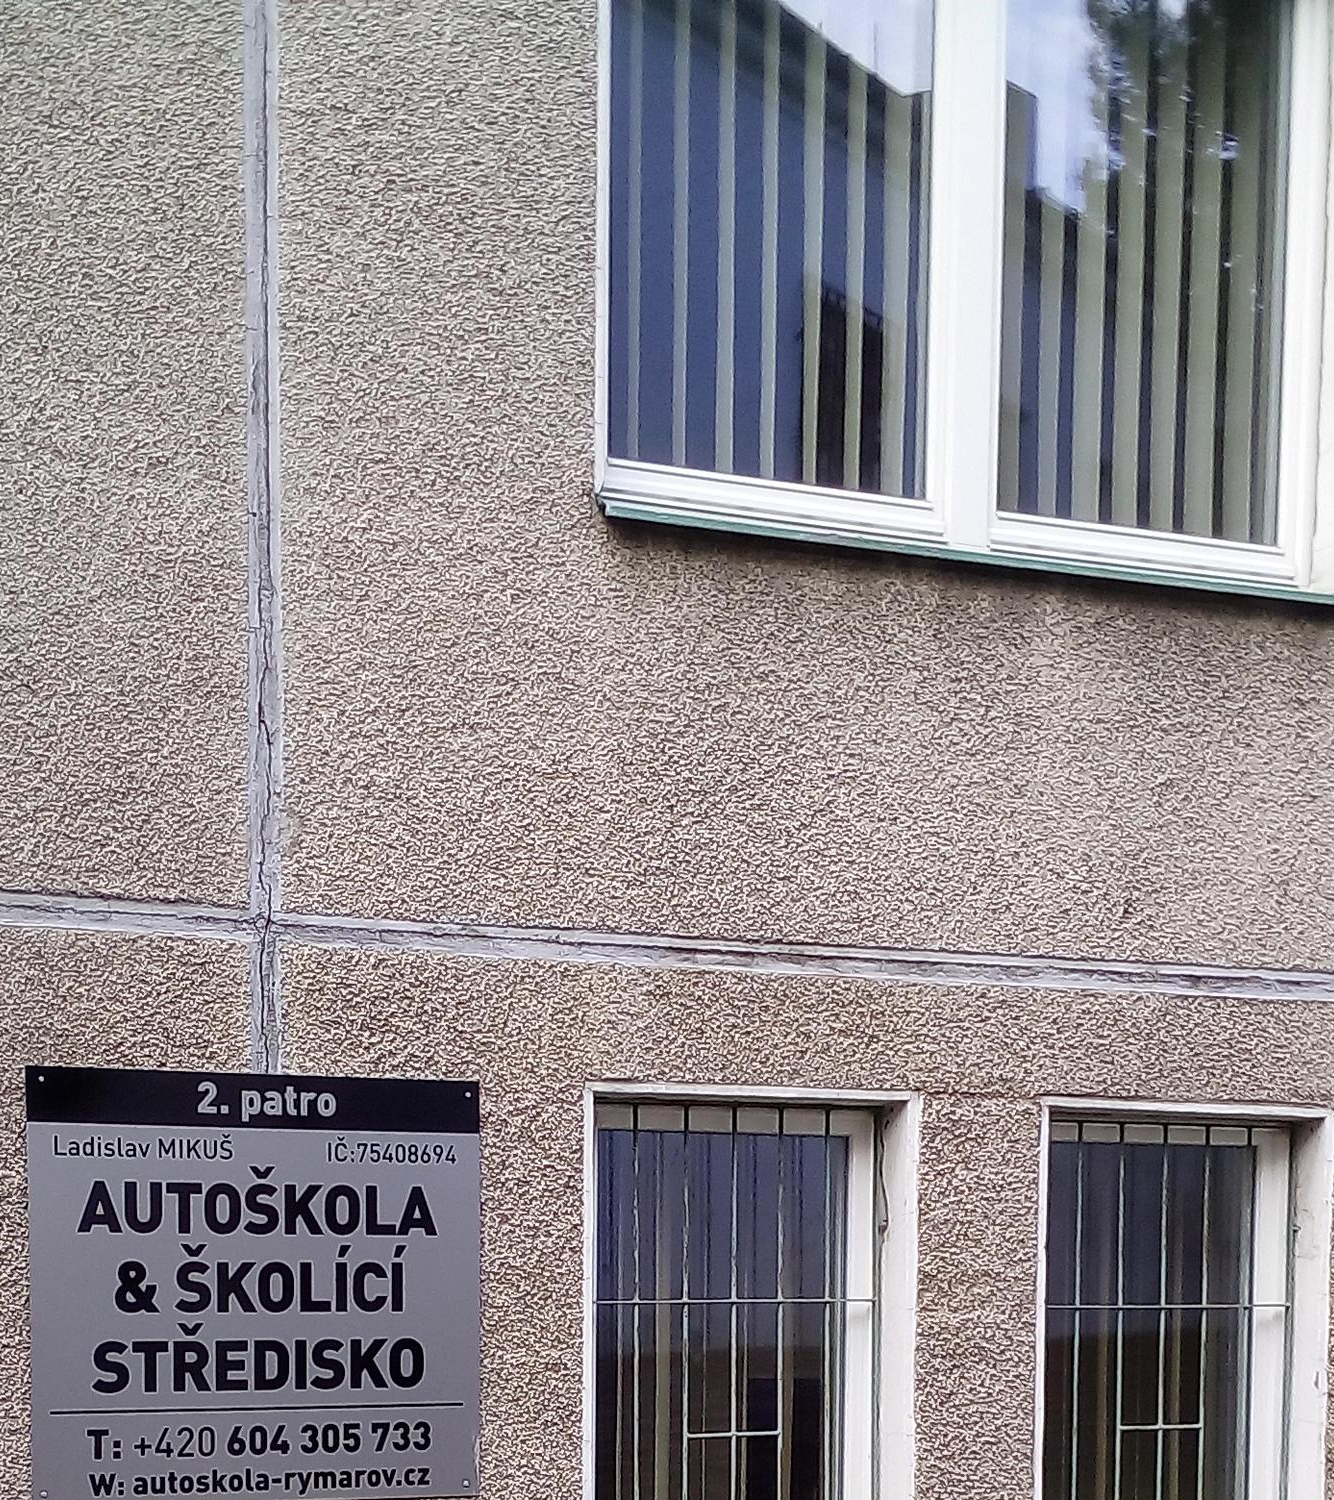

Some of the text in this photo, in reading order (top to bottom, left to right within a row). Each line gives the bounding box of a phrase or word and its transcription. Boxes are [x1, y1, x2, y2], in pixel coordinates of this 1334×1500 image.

[197, 1082, 338, 1122] 2. patro
[53, 1133, 457, 1165] Ladislav MIKUŠ IČ:75408694
[76, 1166, 438, 1237] AUTOŠKOLA
[114, 1243, 408, 1313] & ŠKOLÍCÍ
[91, 1323, 426, 1395] STŘEDISKO
[87, 1421, 431, 1460] T: +420 604 305 733
[89, 1466, 431, 1497] W: autoskola-rymarov.cz
